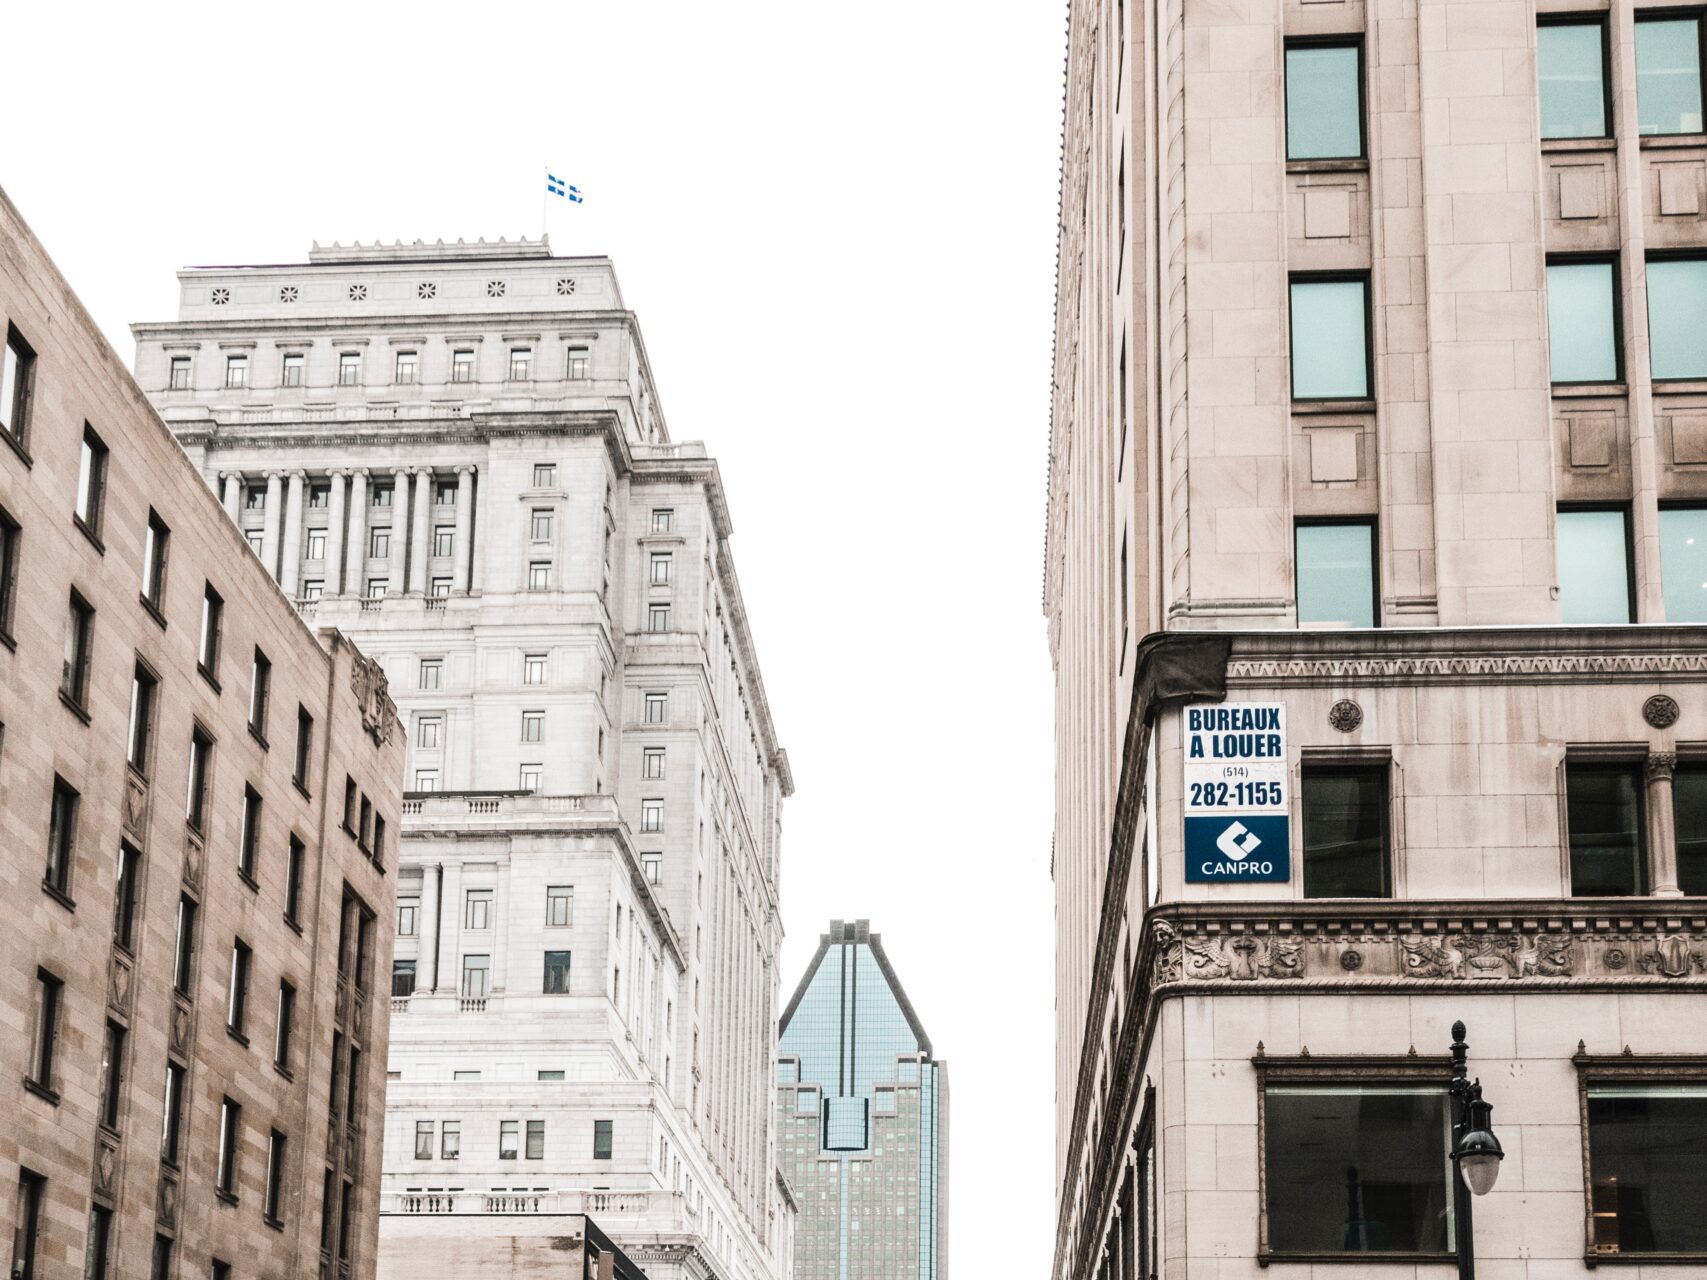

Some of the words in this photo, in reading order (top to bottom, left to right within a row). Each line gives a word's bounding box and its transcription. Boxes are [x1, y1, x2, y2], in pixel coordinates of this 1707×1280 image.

[1189, 708, 1281, 732] BUREAUX
[1212, 734, 1282, 758] LOUER
[1222, 767, 1249, 778] (514)
[1190, 782, 1282, 806] 282-1155
[1201, 861, 1273, 875] CANPRO
